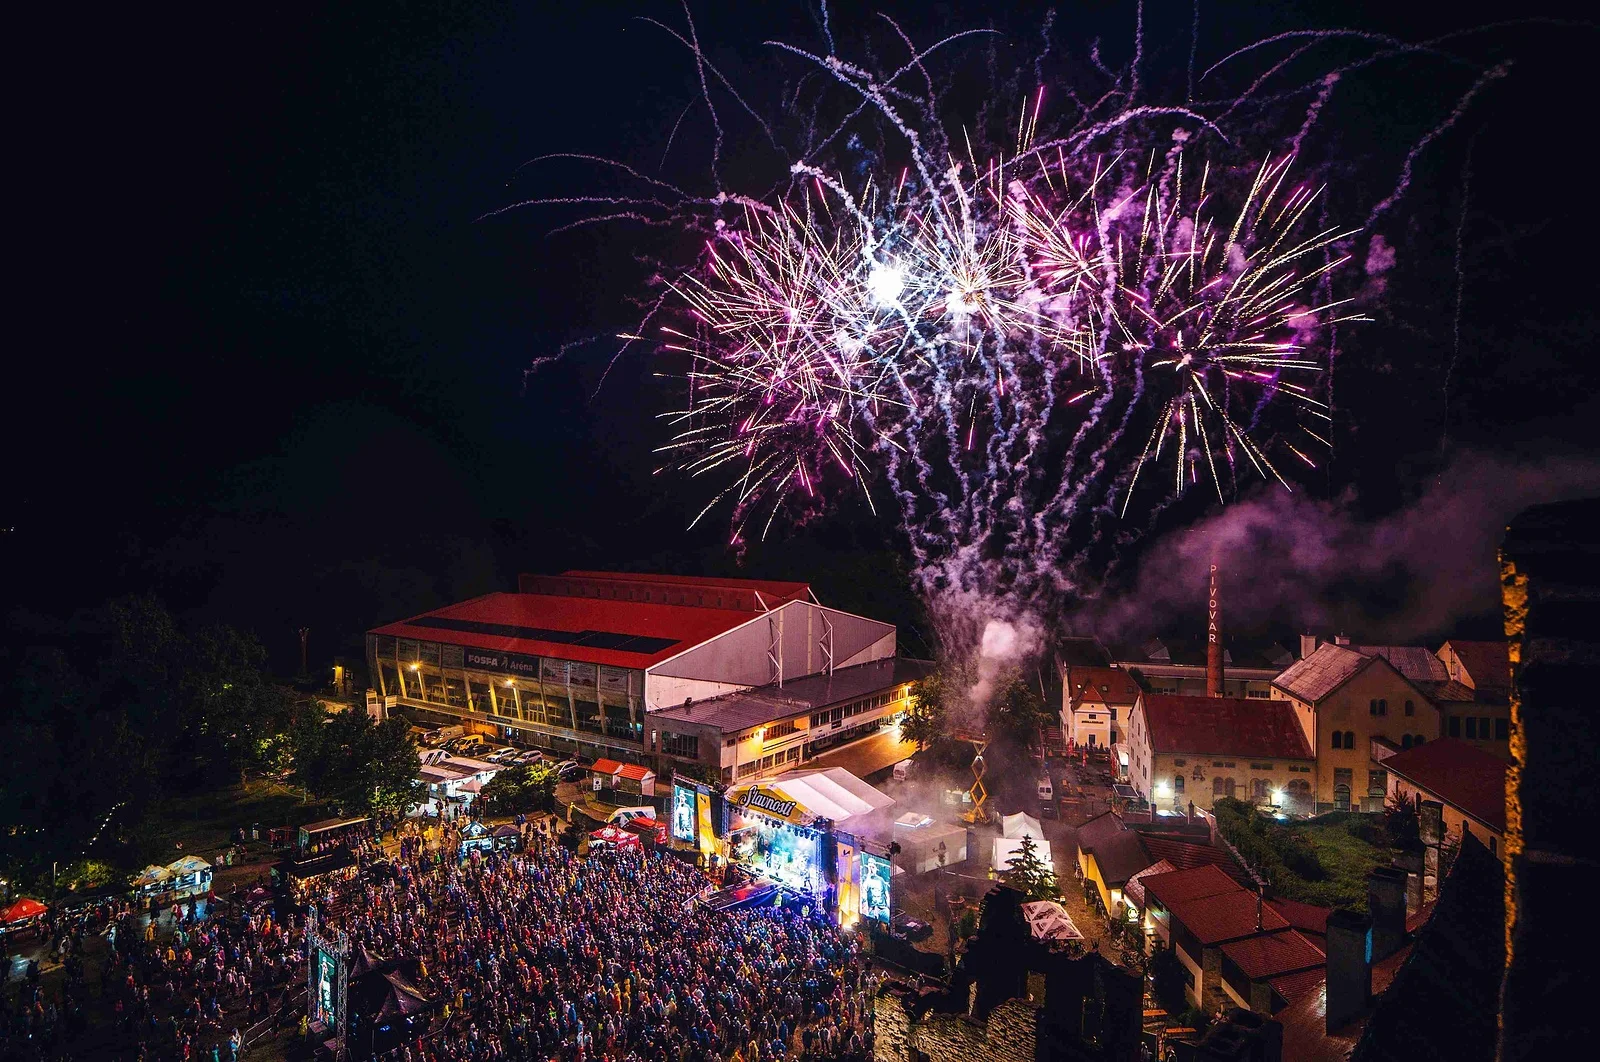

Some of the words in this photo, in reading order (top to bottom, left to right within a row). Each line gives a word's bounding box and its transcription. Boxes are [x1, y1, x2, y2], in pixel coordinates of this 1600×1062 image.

[1208, 564, 1217, 643] PIVOVAR
[468, 654, 498, 667] FOSFA
[510, 660, 533, 672] Aréna
[738, 785, 796, 817] Slavnosti
